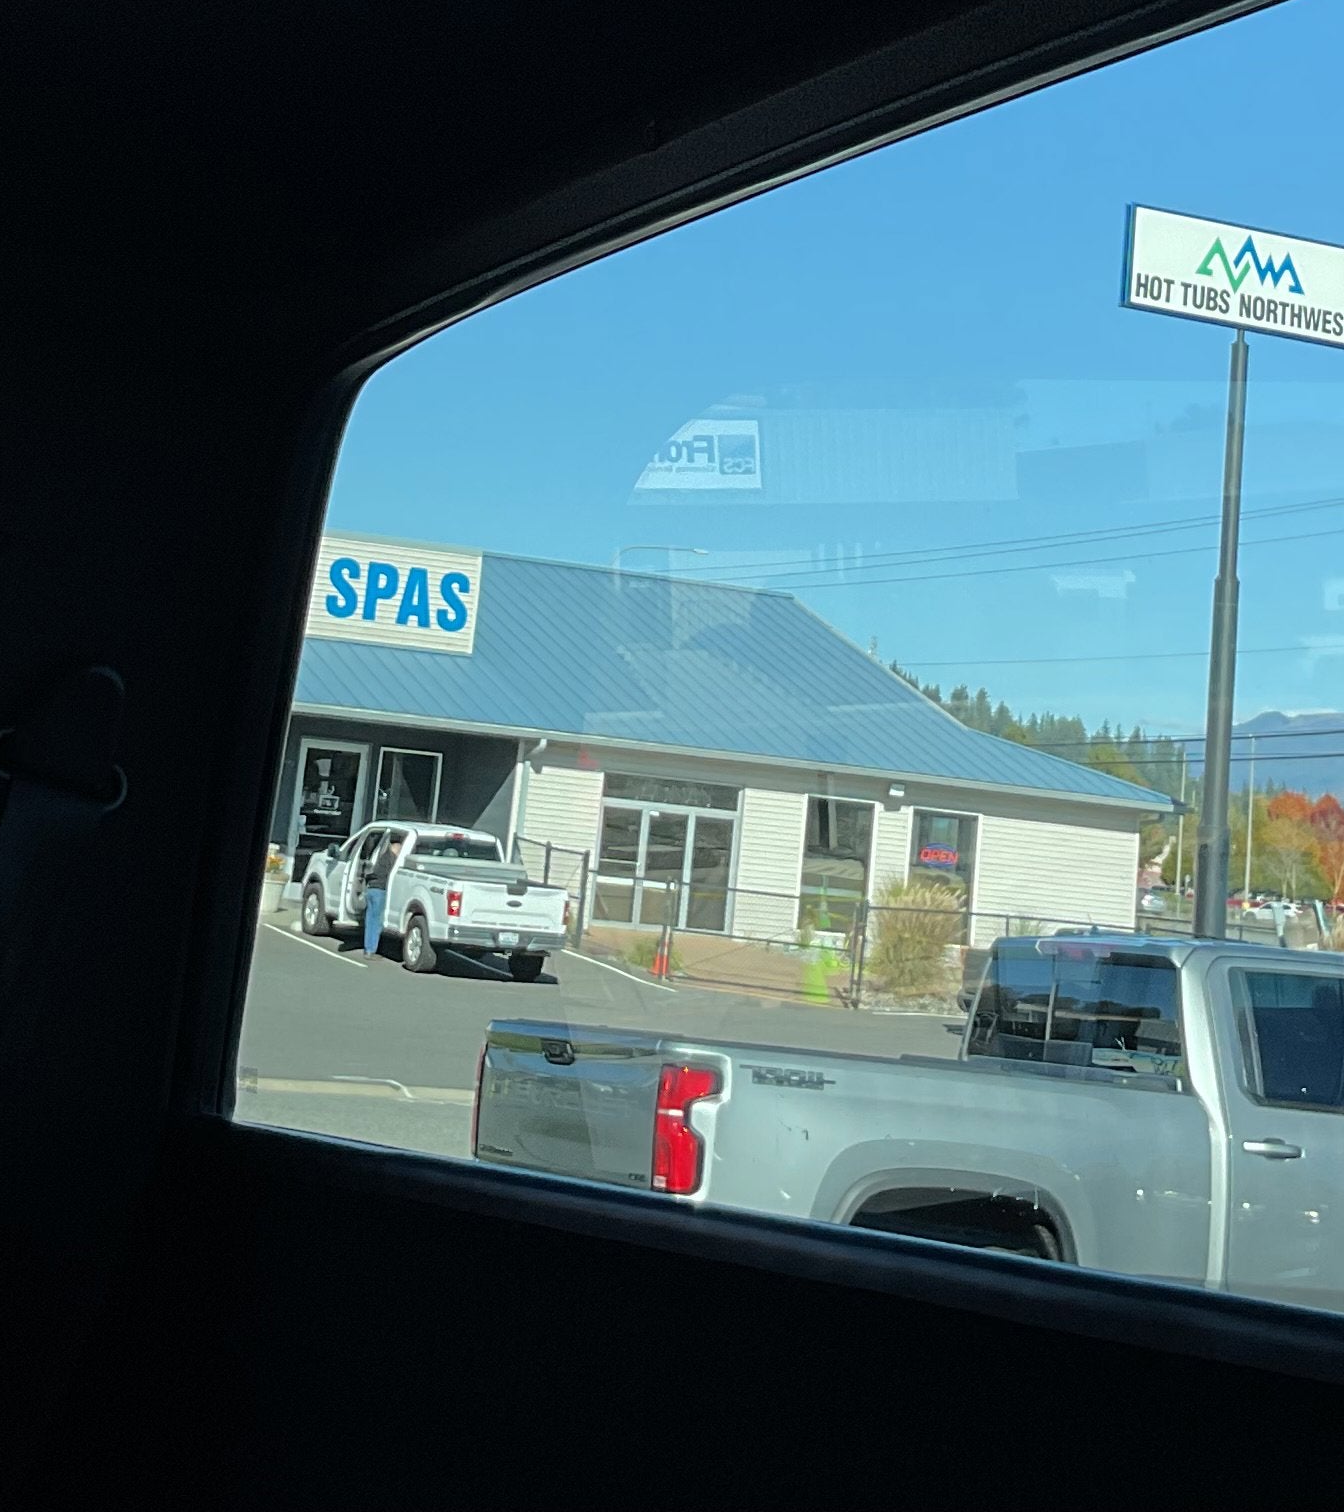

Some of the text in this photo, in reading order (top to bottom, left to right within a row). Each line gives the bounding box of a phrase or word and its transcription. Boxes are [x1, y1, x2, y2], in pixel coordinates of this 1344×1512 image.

[1136, 273, 1175, 303] HOT
[1180, 281, 1230, 314] TUBS
[325, 557, 471, 632] SPAS
[920, 848, 959, 865] OPEN
